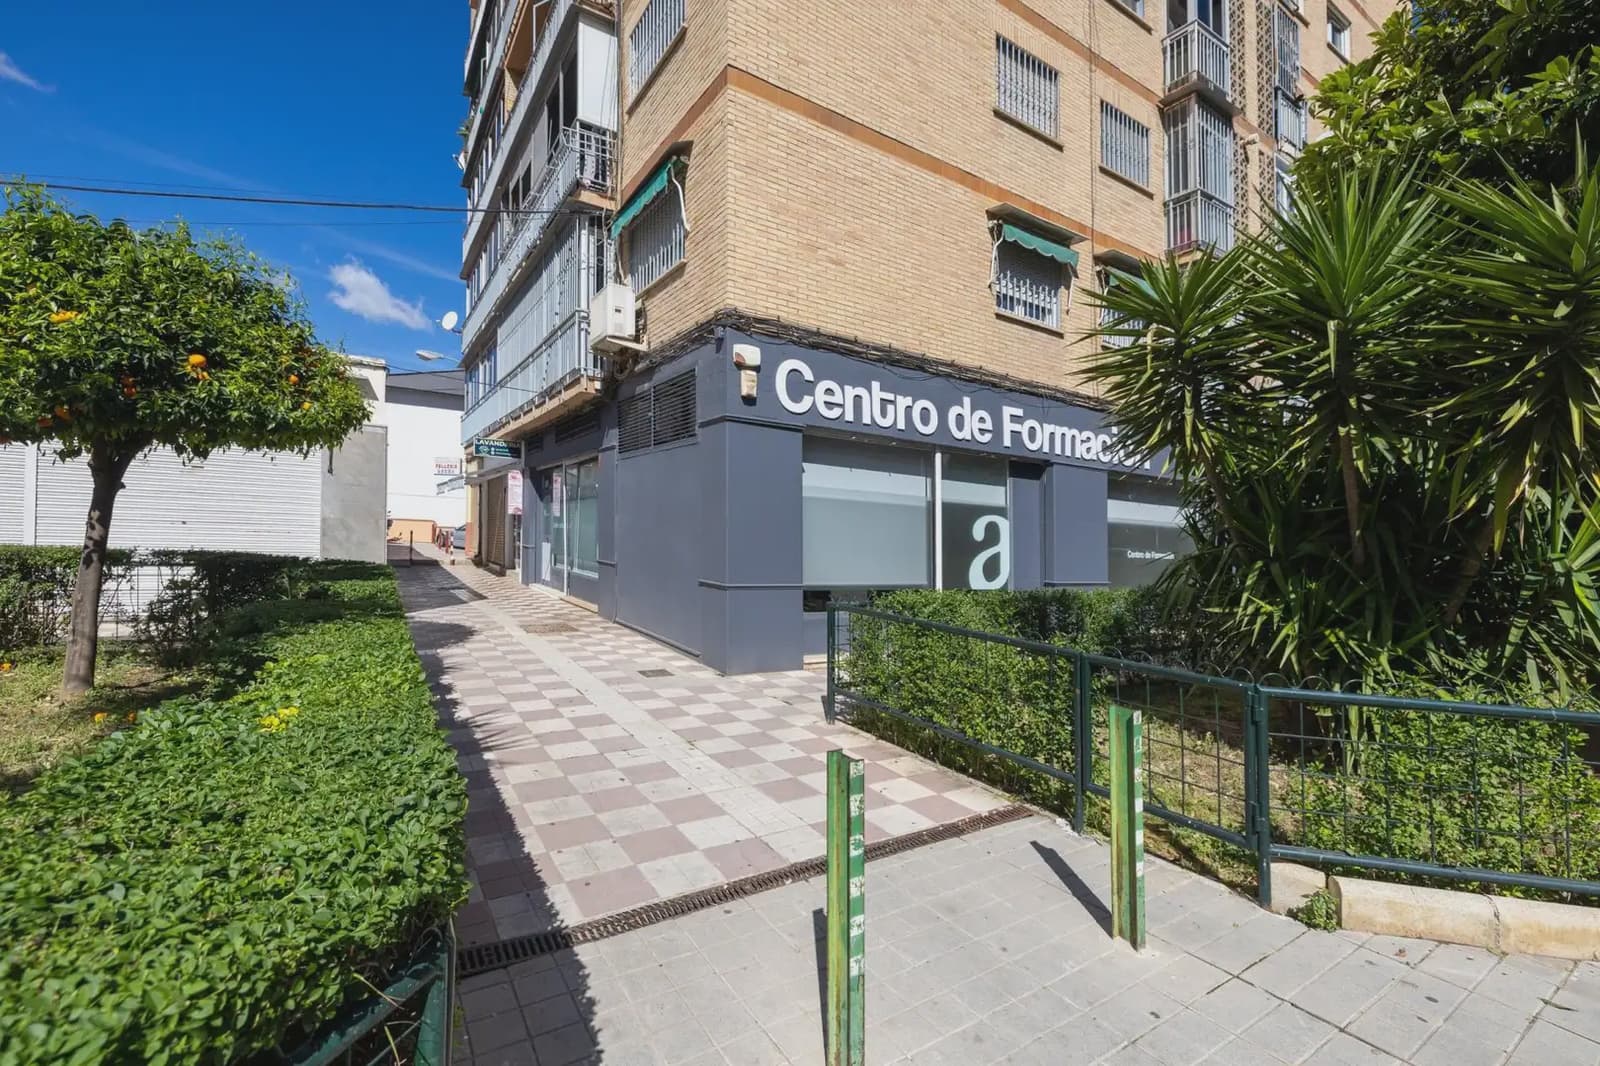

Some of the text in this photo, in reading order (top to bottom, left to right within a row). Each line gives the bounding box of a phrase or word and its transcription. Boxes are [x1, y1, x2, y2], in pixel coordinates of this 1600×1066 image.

[775, 358, 938, 435] Centro
[947, 396, 993, 444] de
[968, 514, 1010, 590] a
[1127, 550, 1144, 559] Centro
